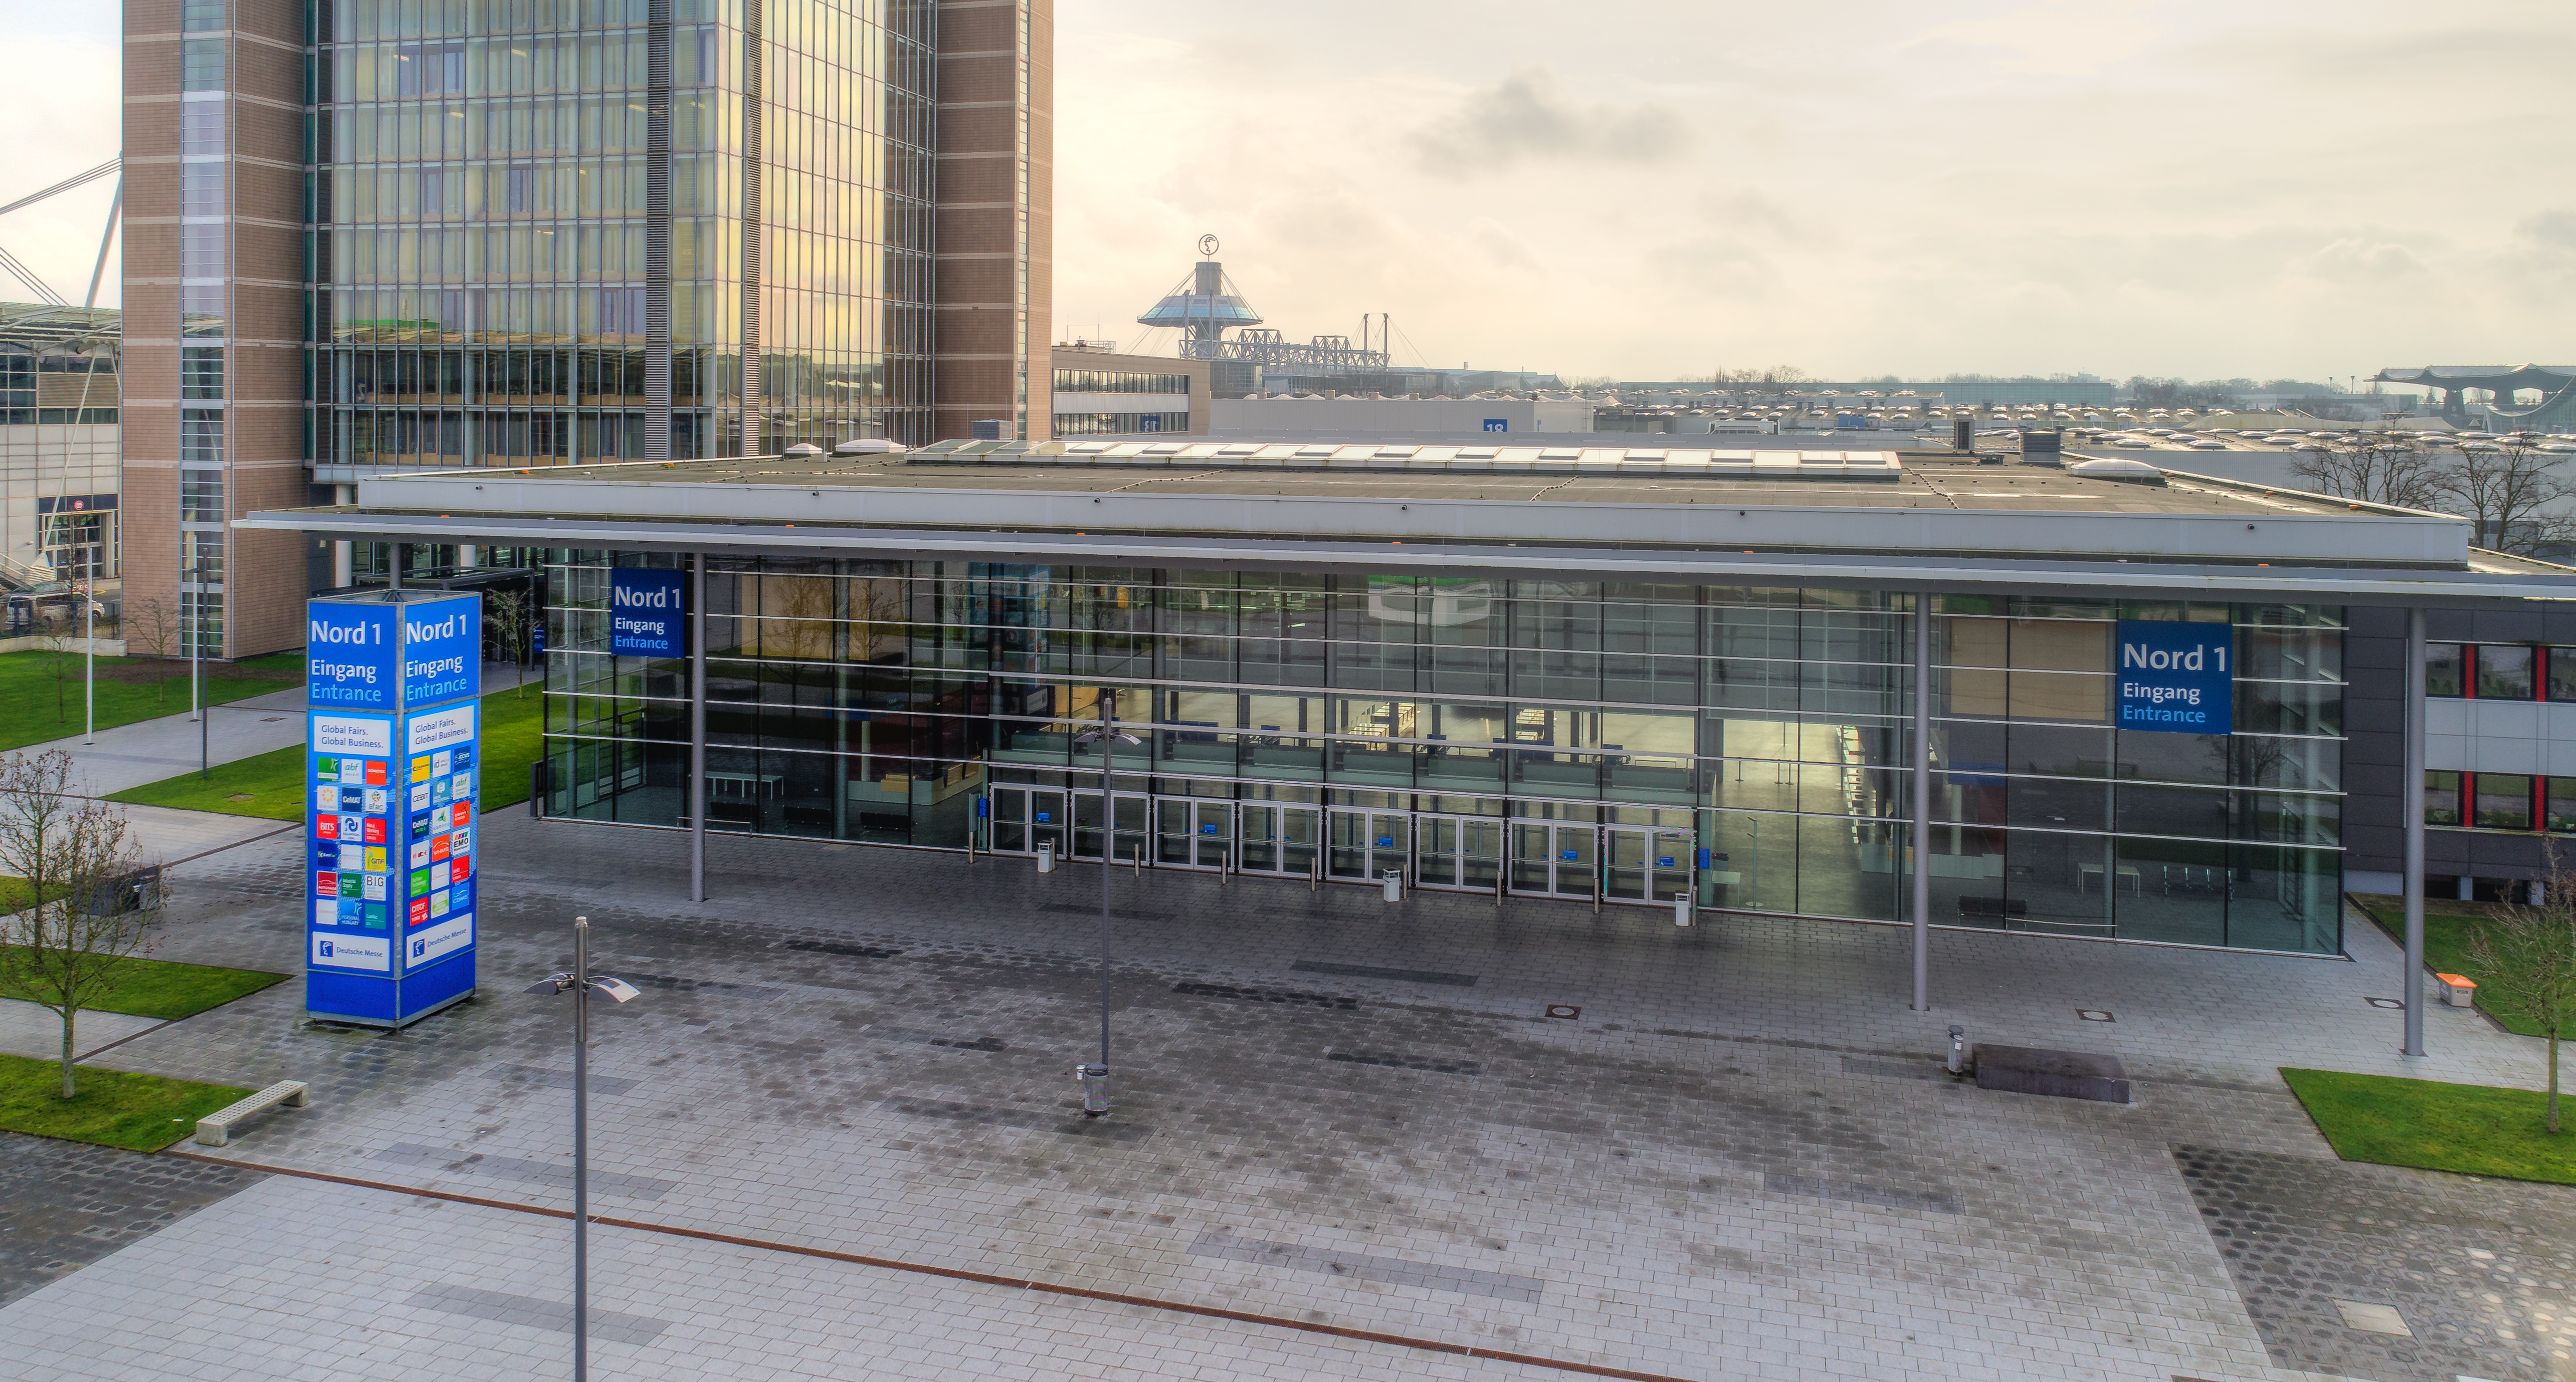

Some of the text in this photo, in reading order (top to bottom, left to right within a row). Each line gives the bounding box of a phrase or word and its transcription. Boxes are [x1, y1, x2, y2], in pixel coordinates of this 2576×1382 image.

[615, 586, 680, 608] Nord 1
[311, 620, 381, 645] Nord 1
[406, 614, 466, 645] Nord 1
[616, 617, 665, 635] Eingang
[616, 635, 668, 649] Entrance
[2124, 643, 2225, 671] Nord 1
[311, 659, 377, 683] Eingang
[406, 656, 463, 678] Eingang
[312, 682, 381, 702] Entrance
[407, 678, 467, 702] Entrance
[2124, 682, 2200, 705] Eingang
[2124, 705, 2206, 723] Entrance
[321, 725, 368, 736] Global Fairs.
[416, 718, 456, 734] Global Fairs.
[321, 737, 384, 748] Global Business.
[415, 728, 469, 745] Global Business.
[345, 763, 360, 771] abf
[434, 759, 440, 769] id
[456, 777, 468, 787] abf
[454, 838, 469, 848] EMO
[367, 876, 384, 886] BIG
[428, 928, 467, 948] Deutsche Messe
[336, 947, 383, 957] Deutsche Messe
